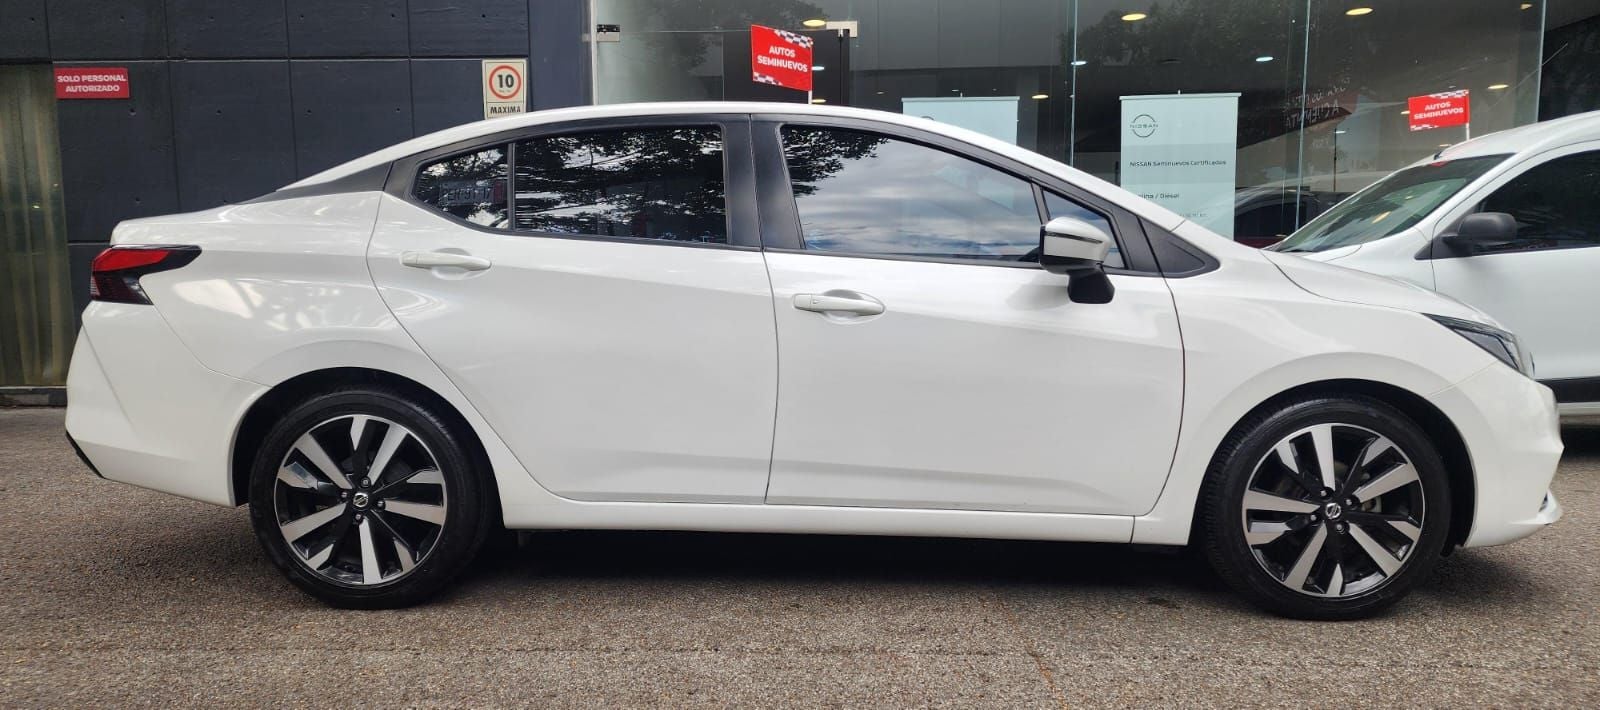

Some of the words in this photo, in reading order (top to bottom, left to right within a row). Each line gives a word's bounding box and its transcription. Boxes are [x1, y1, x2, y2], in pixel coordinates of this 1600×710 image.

[769, 46, 795, 57] AUTOS
[757, 55, 808, 72] SEMINUEVOS
[497, 74, 514, 88] 10
[490, 106, 521, 114] MAXIMA
[1424, 101, 1451, 110] AUTOS
[1413, 107, 1463, 119] SEMINUEVOS
